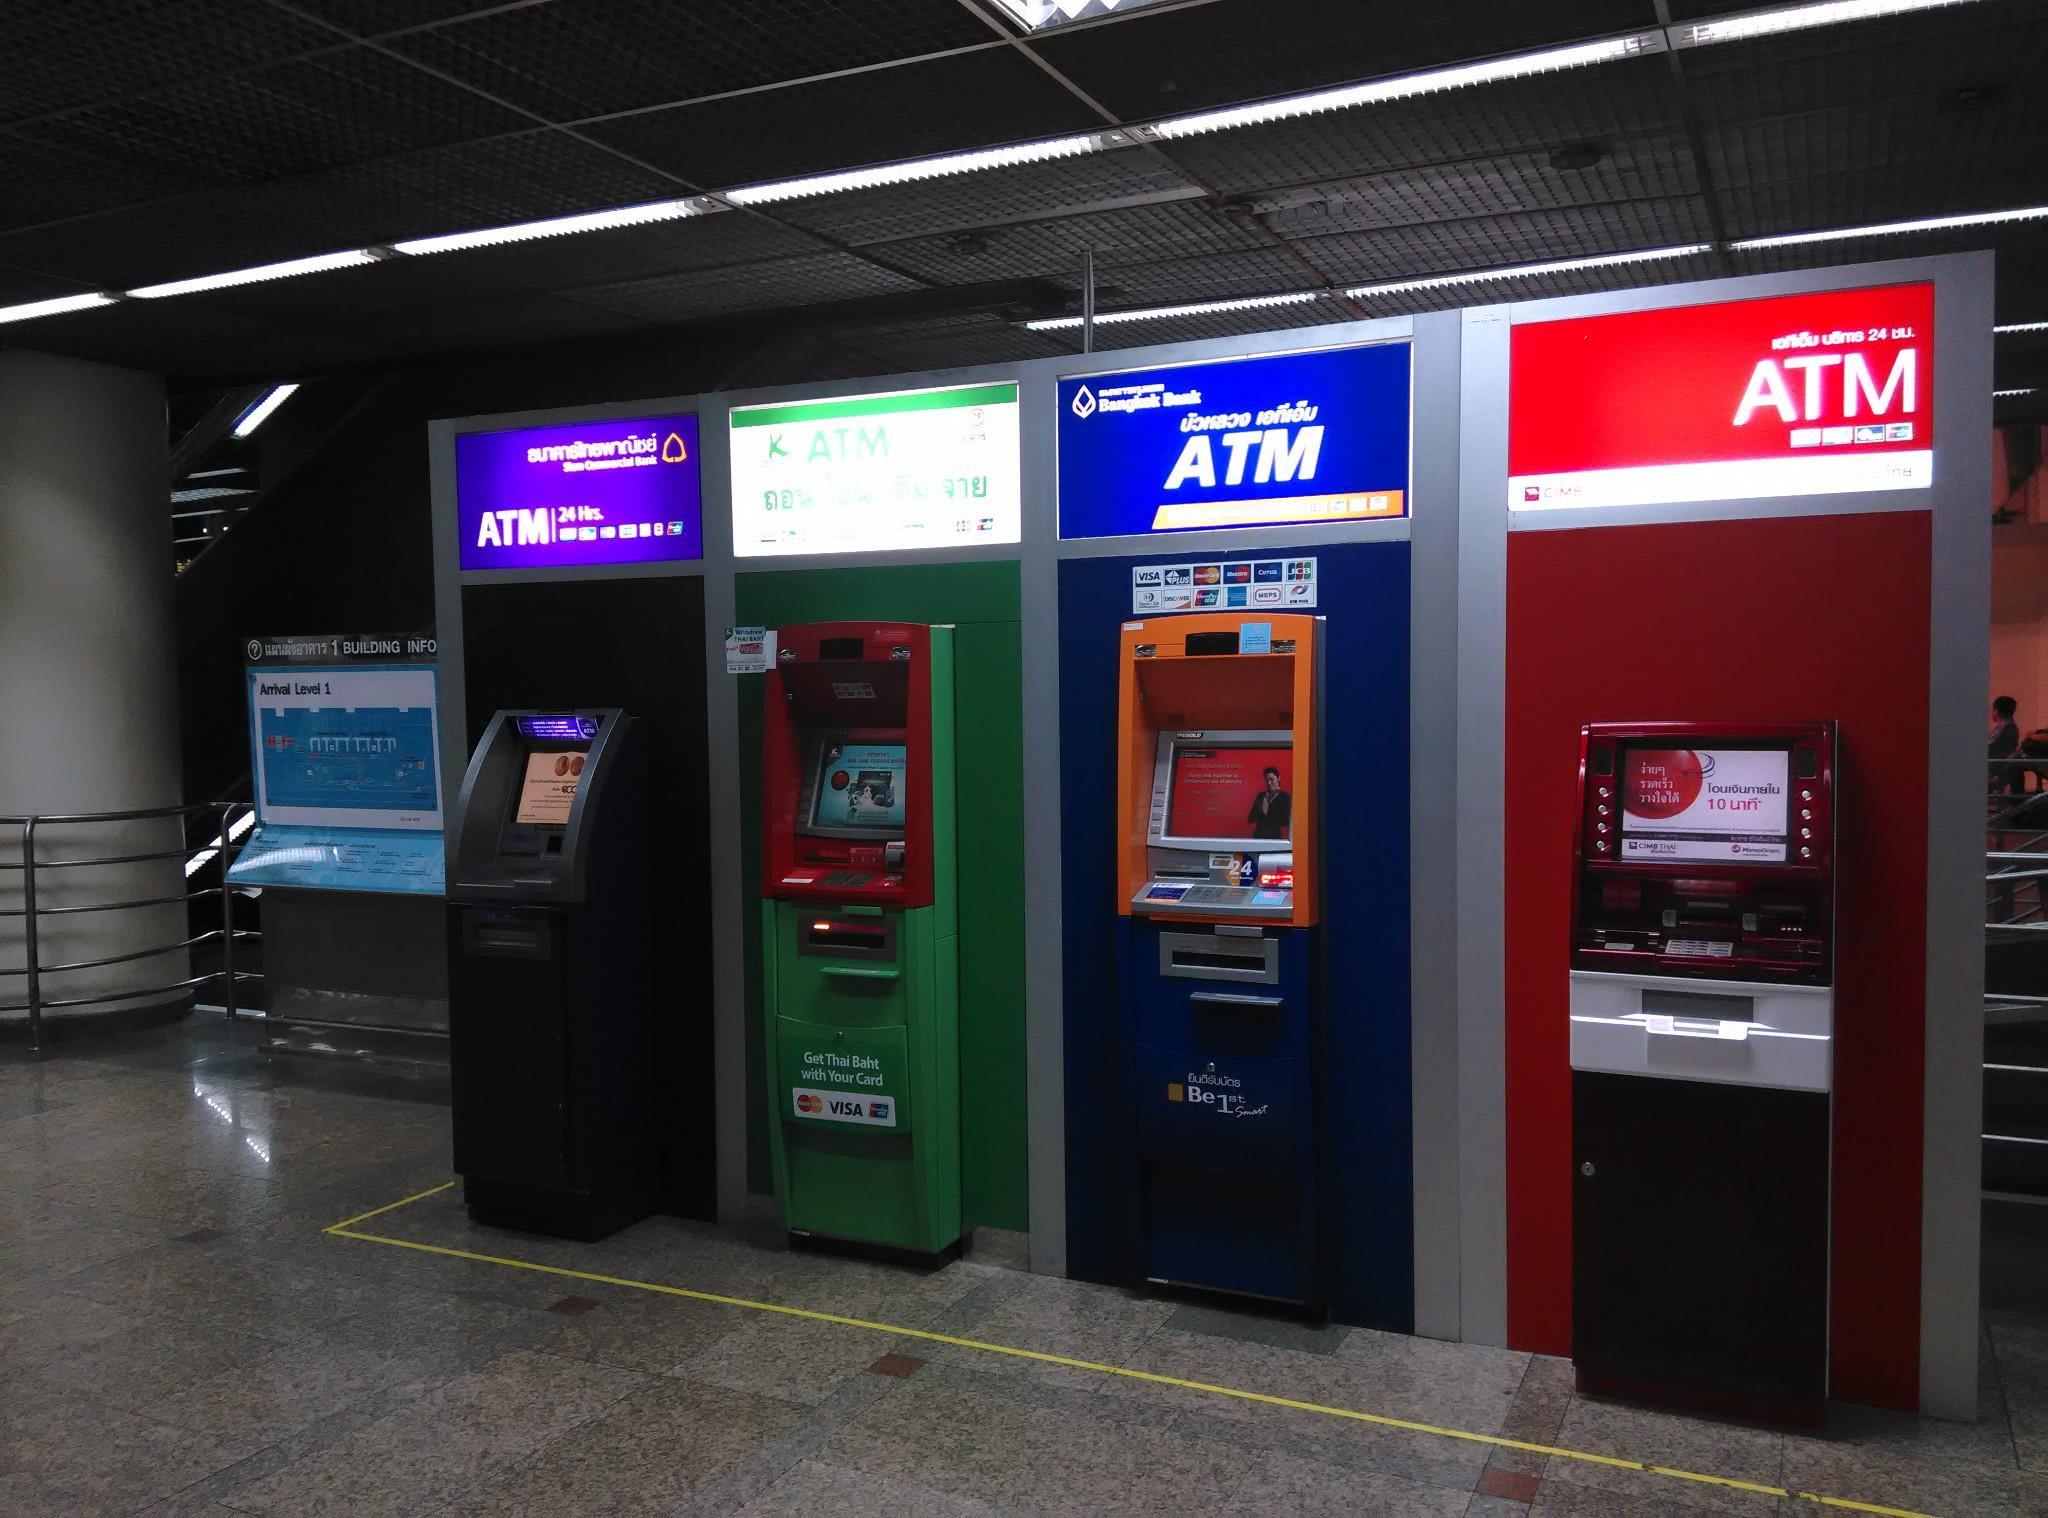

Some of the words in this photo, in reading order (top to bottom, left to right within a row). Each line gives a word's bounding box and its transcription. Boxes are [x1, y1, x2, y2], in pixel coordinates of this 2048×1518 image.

[1868, 328, 1887, 341] 24
[1732, 347, 1917, 426] ATM
[1162, 389, 1202, 407] Bank
[1180, 408, 1252, 433] บัวหลวง
[1256, 400, 1319, 427] เอทีเอ็ม
[807, 424, 891, 464] ATM
[1163, 425, 1325, 490] ATM
[557, 507, 578, 523] 24
[477, 507, 550, 548] ATM
[1138, 571, 1161, 582] VISA
[1258, 568, 1279, 576] Cirrus
[1287, 567, 1312, 576] JCB
[1172, 575, 1191, 585] PLUS
[331, 639, 338, 656] 1
[343, 641, 400, 655] BUILDING
[407, 640, 437, 653] INFO
[259, 683, 291, 696] Arrival
[295, 683, 321, 695] Level
[325, 682, 332, 695] 1
[1640, 776, 1674, 790] รวดเร็ว
[1708, 798, 1727, 811] 10
[1638, 842, 1659, 850] CIMB
[1229, 860, 1253, 876] 24
[803, 1052, 824, 1065] Get
[825, 1053, 850, 1067] Thai
[852, 1055, 880, 1070] Baht
[801, 1068, 826, 1082] with
[828, 1070, 855, 1084] Your
[856, 1073, 884, 1087] Card
[1188, 1085, 1216, 1104] Be
[829, 1101, 863, 1117] VISA
[1234, 1104, 1269, 1119] Smart
